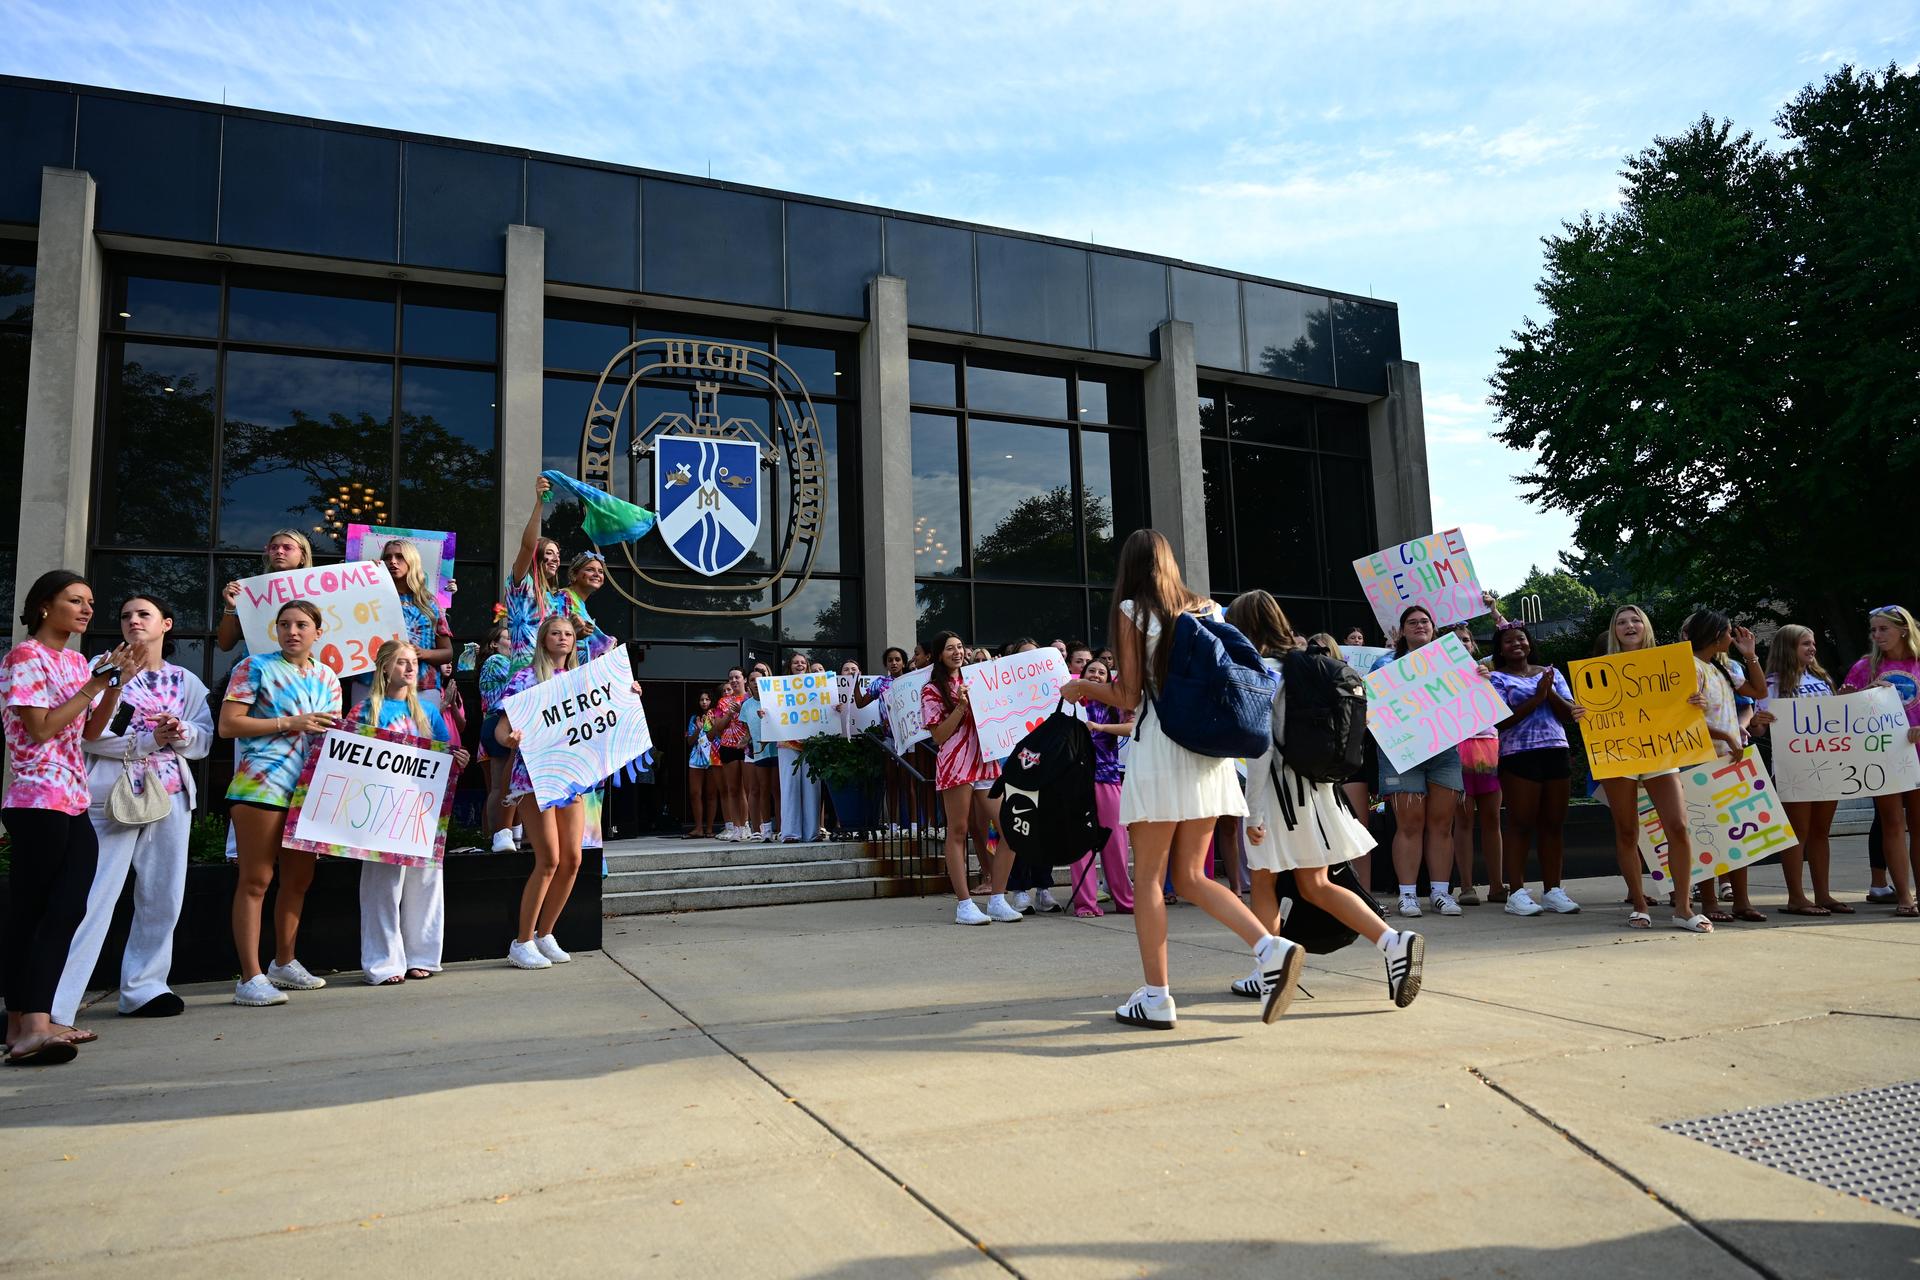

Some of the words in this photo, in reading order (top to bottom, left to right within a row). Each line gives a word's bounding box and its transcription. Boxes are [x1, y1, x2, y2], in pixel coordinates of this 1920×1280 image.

[665, 341, 750, 372] HIGH
[794, 416, 825, 542] SCHOOL
[697, 486, 720, 511] M
[1358, 528, 1465, 582] WELCOME
[244, 564, 380, 609] WELCOME
[353, 598, 383, 625] OF
[979, 657, 1054, 693] Welcome
[1621, 660, 1681, 698] Smile
[541, 682, 612, 728] MERCY
[1638, 708, 1651, 724] A
[1793, 701, 1904, 735] Welcome
[566, 710, 617, 747] 2030
[996, 726, 1018, 749] WE
[1590, 727, 1704, 766] FRESHMAN
[1789, 736, 1852, 753] CLASS
[1864, 734, 1893, 752] OF
[328, 738, 441, 779] WELCOME!
[1711, 758, 1788, 857] FRESH
[1014, 817, 1030, 836] 29
